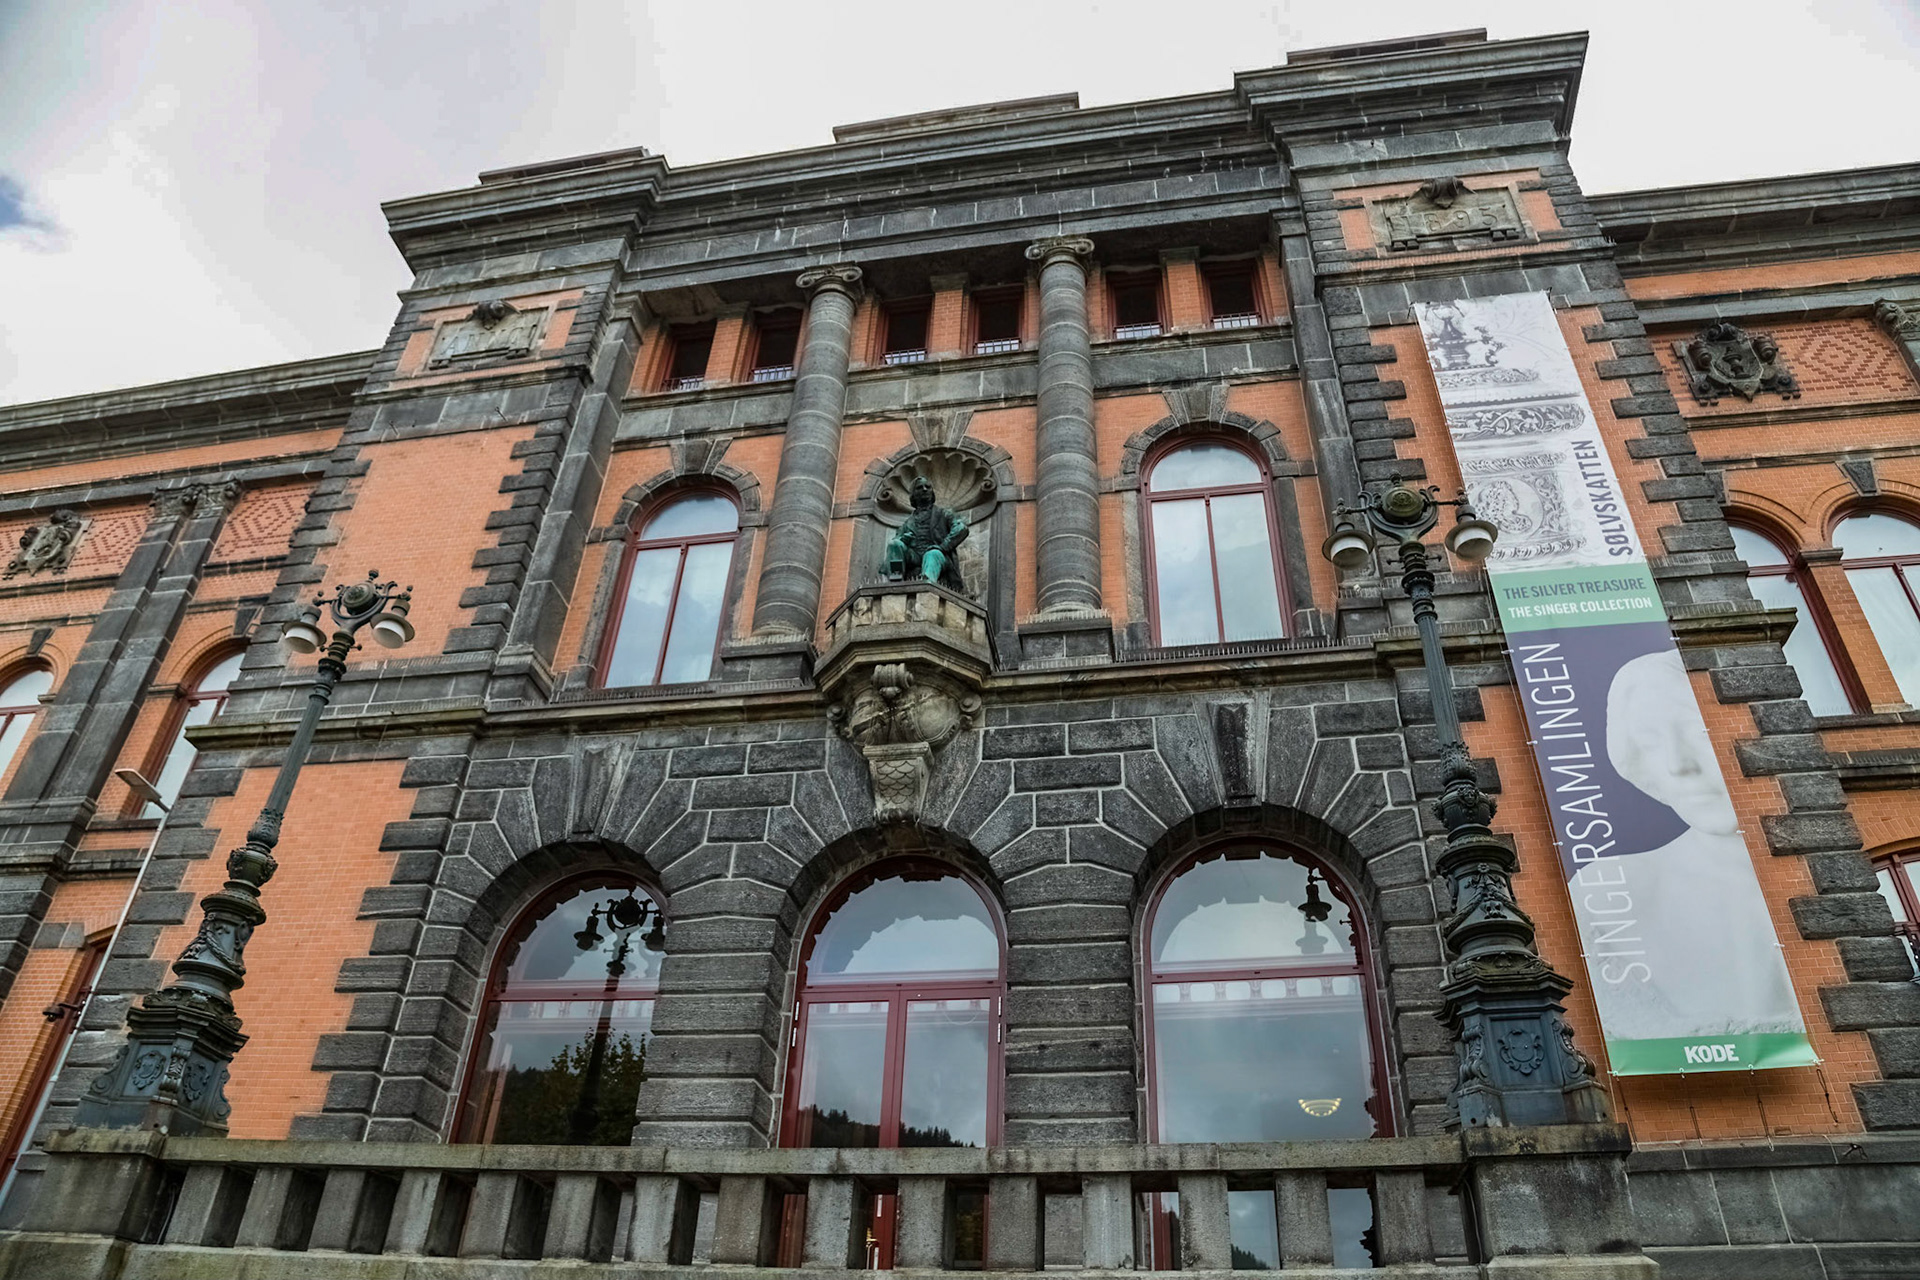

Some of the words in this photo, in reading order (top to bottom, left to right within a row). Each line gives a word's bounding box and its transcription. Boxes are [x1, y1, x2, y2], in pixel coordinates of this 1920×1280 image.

[1400, 207, 1498, 235] 1895
[1571, 440, 1633, 556] SØLVSKATTEN
[1503, 587, 1530, 600] THE
[1532, 582, 1577, 598] SILVER
[1577, 577, 1646, 594] TREASURE
[1508, 606, 1533, 619] THE
[1535, 602, 1579, 616] SINGER
[1580, 597, 1653, 613] COLLECTION
[1519, 643, 1651, 984] SINGERSAMLINGEN
[1683, 1044, 1740, 1064] KODE
